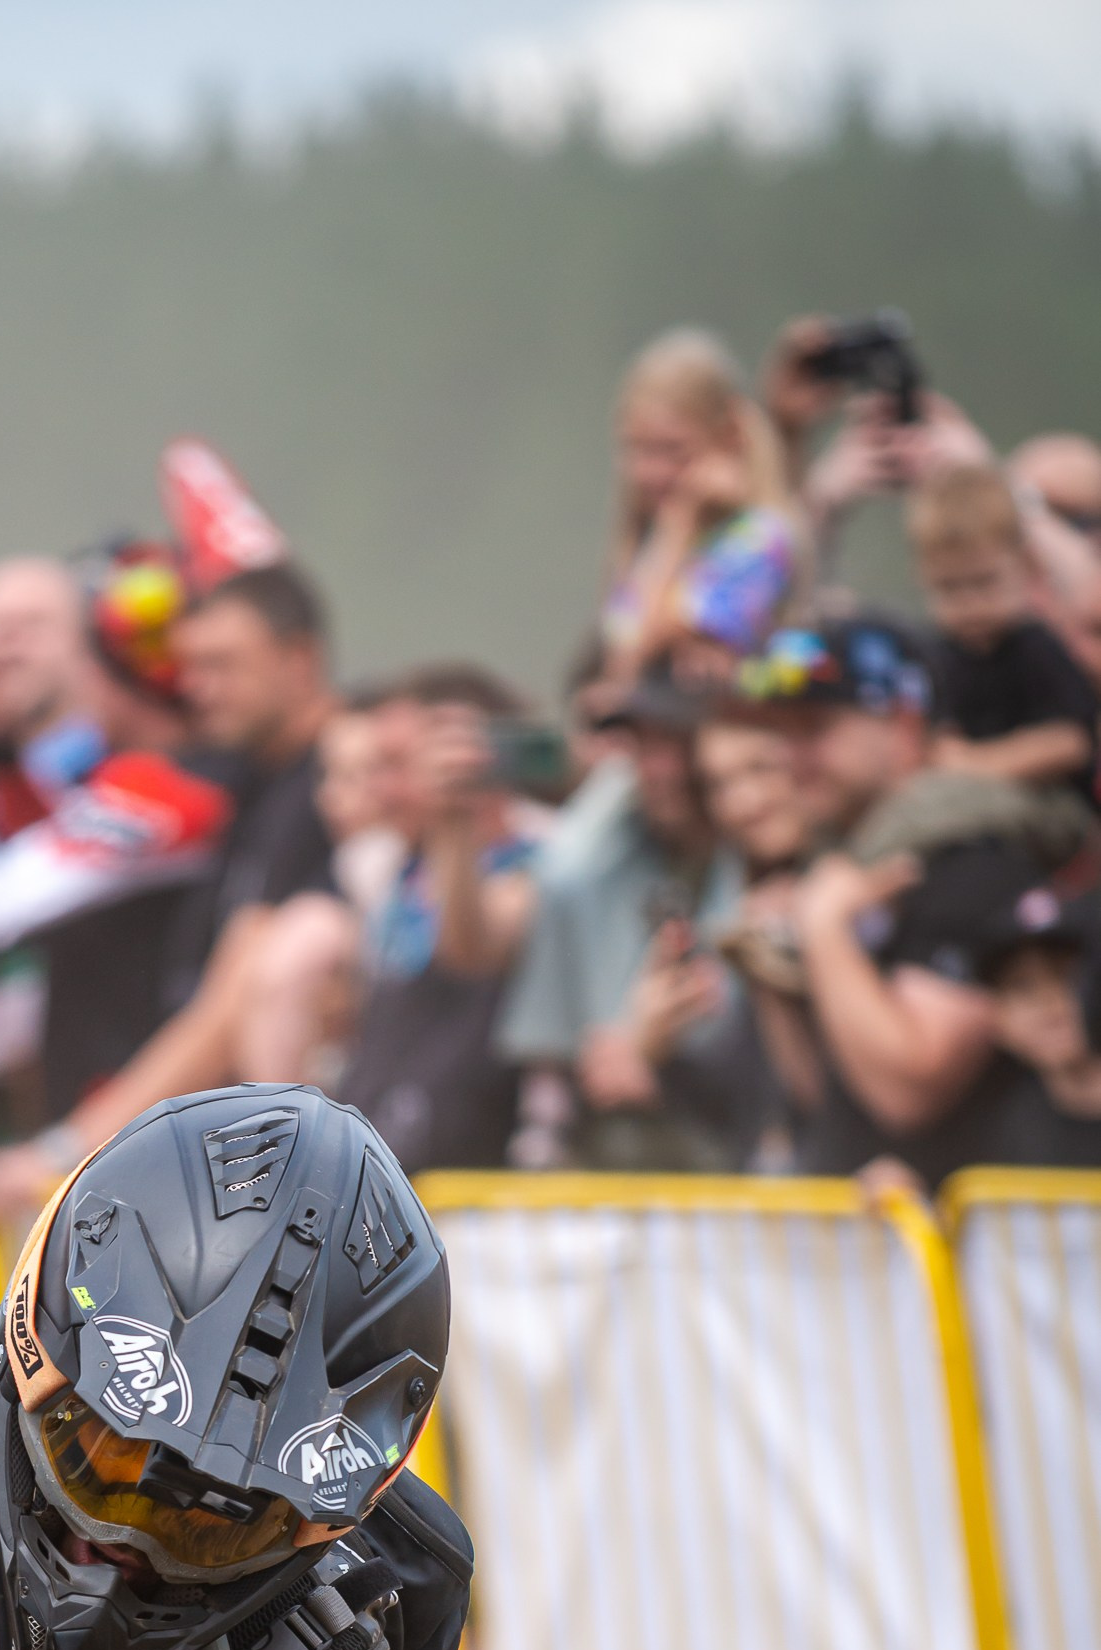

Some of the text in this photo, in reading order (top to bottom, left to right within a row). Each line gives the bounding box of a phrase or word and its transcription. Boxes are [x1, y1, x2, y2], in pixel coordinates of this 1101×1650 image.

[100, 1331, 179, 1415] Airoh
[112, 1376, 141, 1409] HELMET
[301, 1428, 376, 1485] Airoh
[318, 1484, 346, 1496] HELMET
